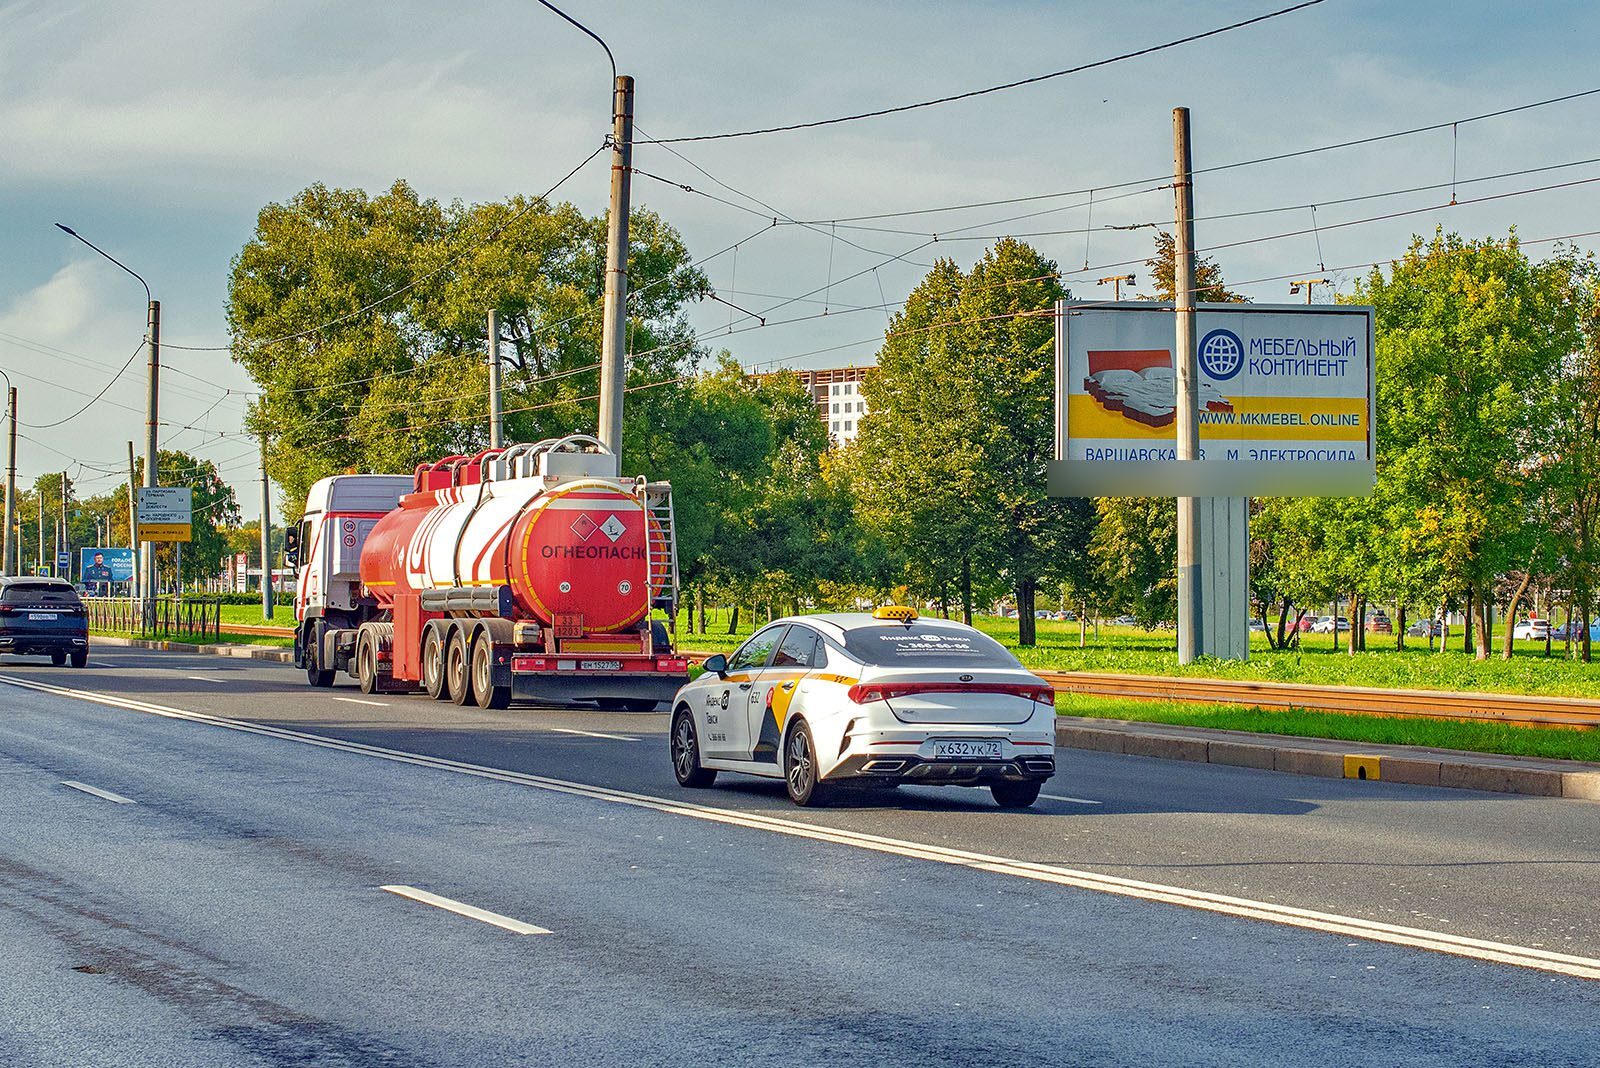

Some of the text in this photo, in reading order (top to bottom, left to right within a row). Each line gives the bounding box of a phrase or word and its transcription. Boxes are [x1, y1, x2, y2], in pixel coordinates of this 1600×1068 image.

[1249, 336, 1356, 357] МЕБЕЛЬНЫЙ
[1249, 358, 1349, 377] КОНТИНЕНТ
[1199, 413, 1360, 426] WWW.MKMEBEL.ONLINE
[620, 583, 629, 591] 70
[562, 617, 574, 625] 33
[557, 627, 579, 635] 1203
[751, 691, 761, 704] 632
